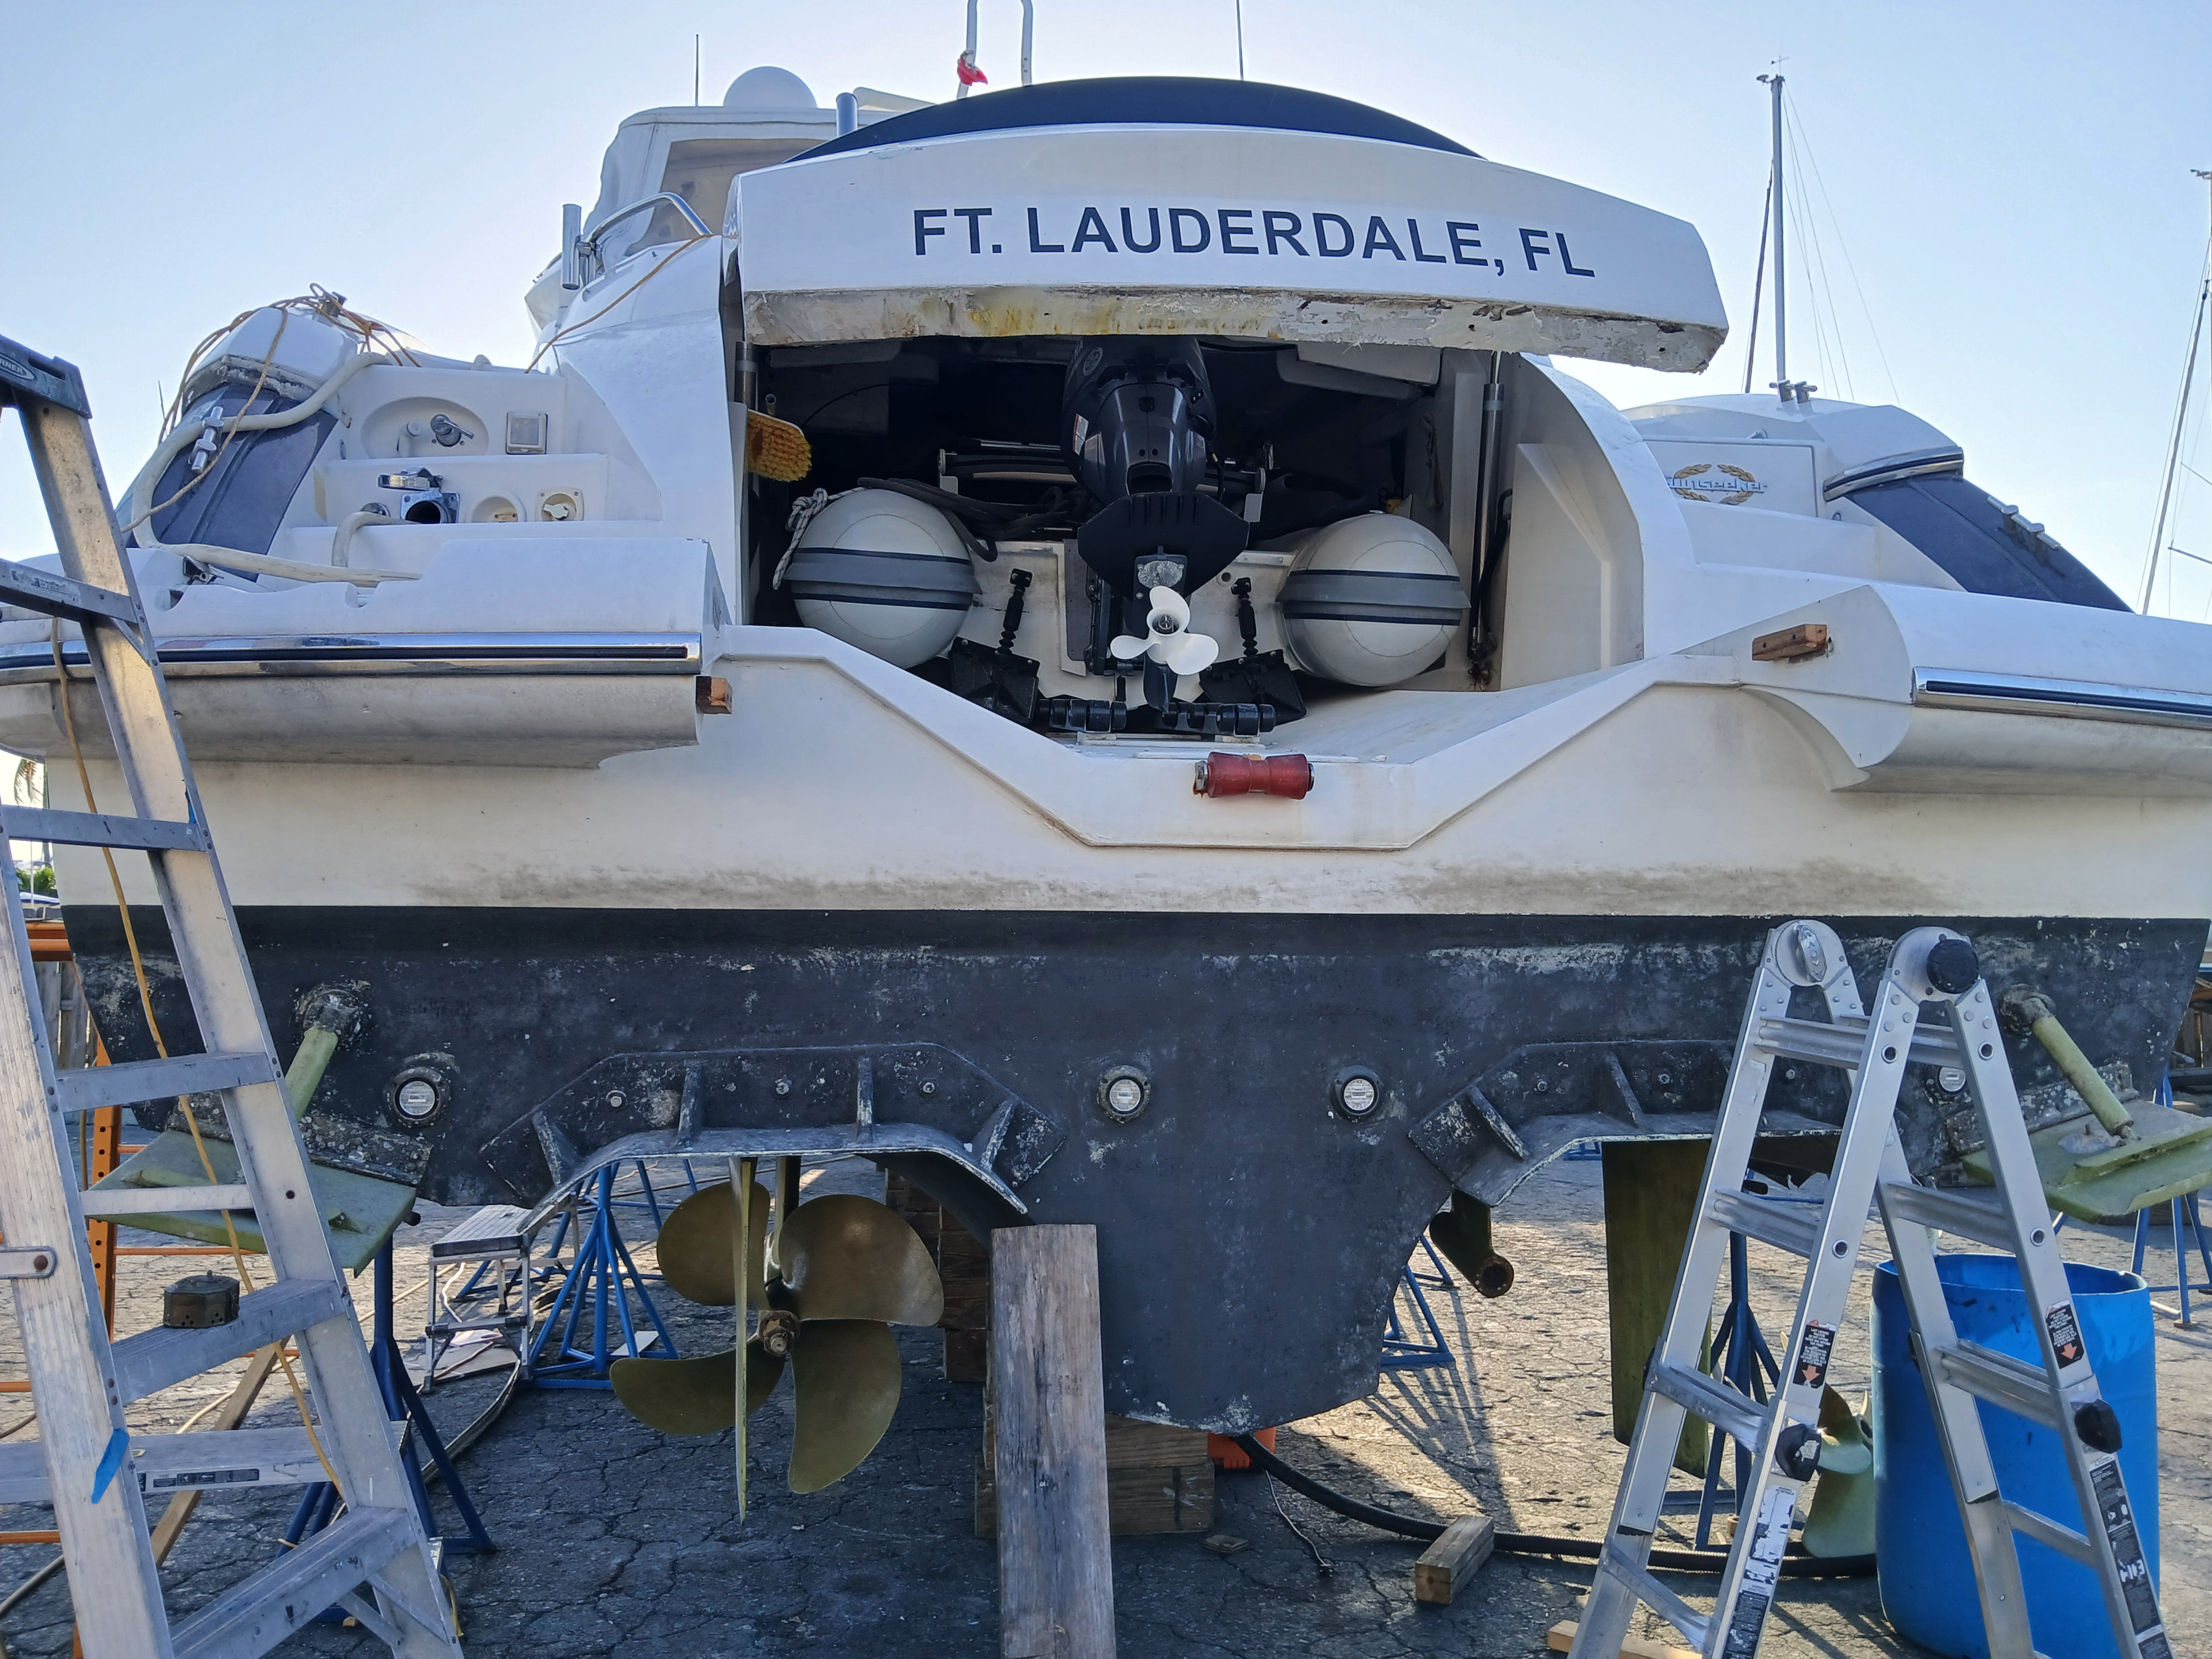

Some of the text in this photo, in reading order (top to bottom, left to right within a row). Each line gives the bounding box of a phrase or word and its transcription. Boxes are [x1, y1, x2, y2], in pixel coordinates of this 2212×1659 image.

[914, 207, 1596, 278] FT. LAUDERDALE, FL
